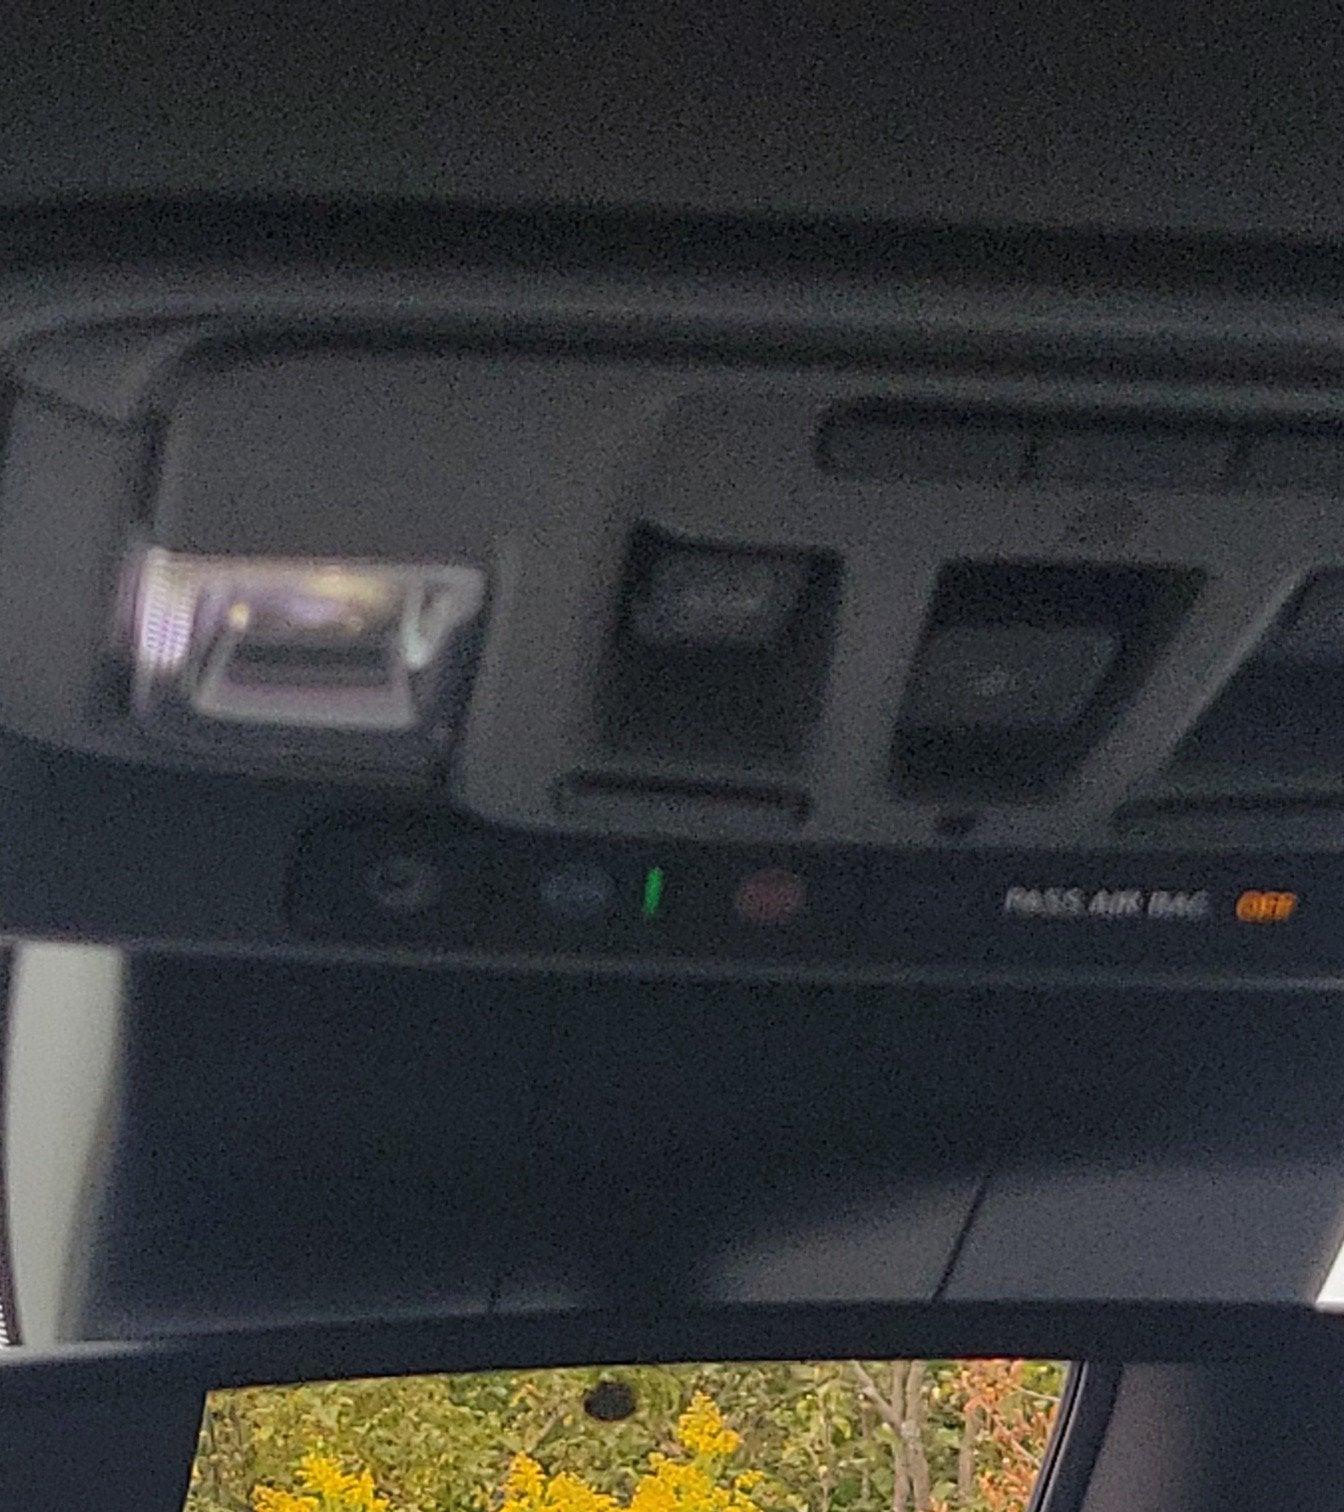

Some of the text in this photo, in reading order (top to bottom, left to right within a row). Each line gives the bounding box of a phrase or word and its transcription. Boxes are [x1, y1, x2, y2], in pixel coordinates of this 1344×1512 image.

[1005, 886, 1297, 922] PASS AIR BAG OFF
